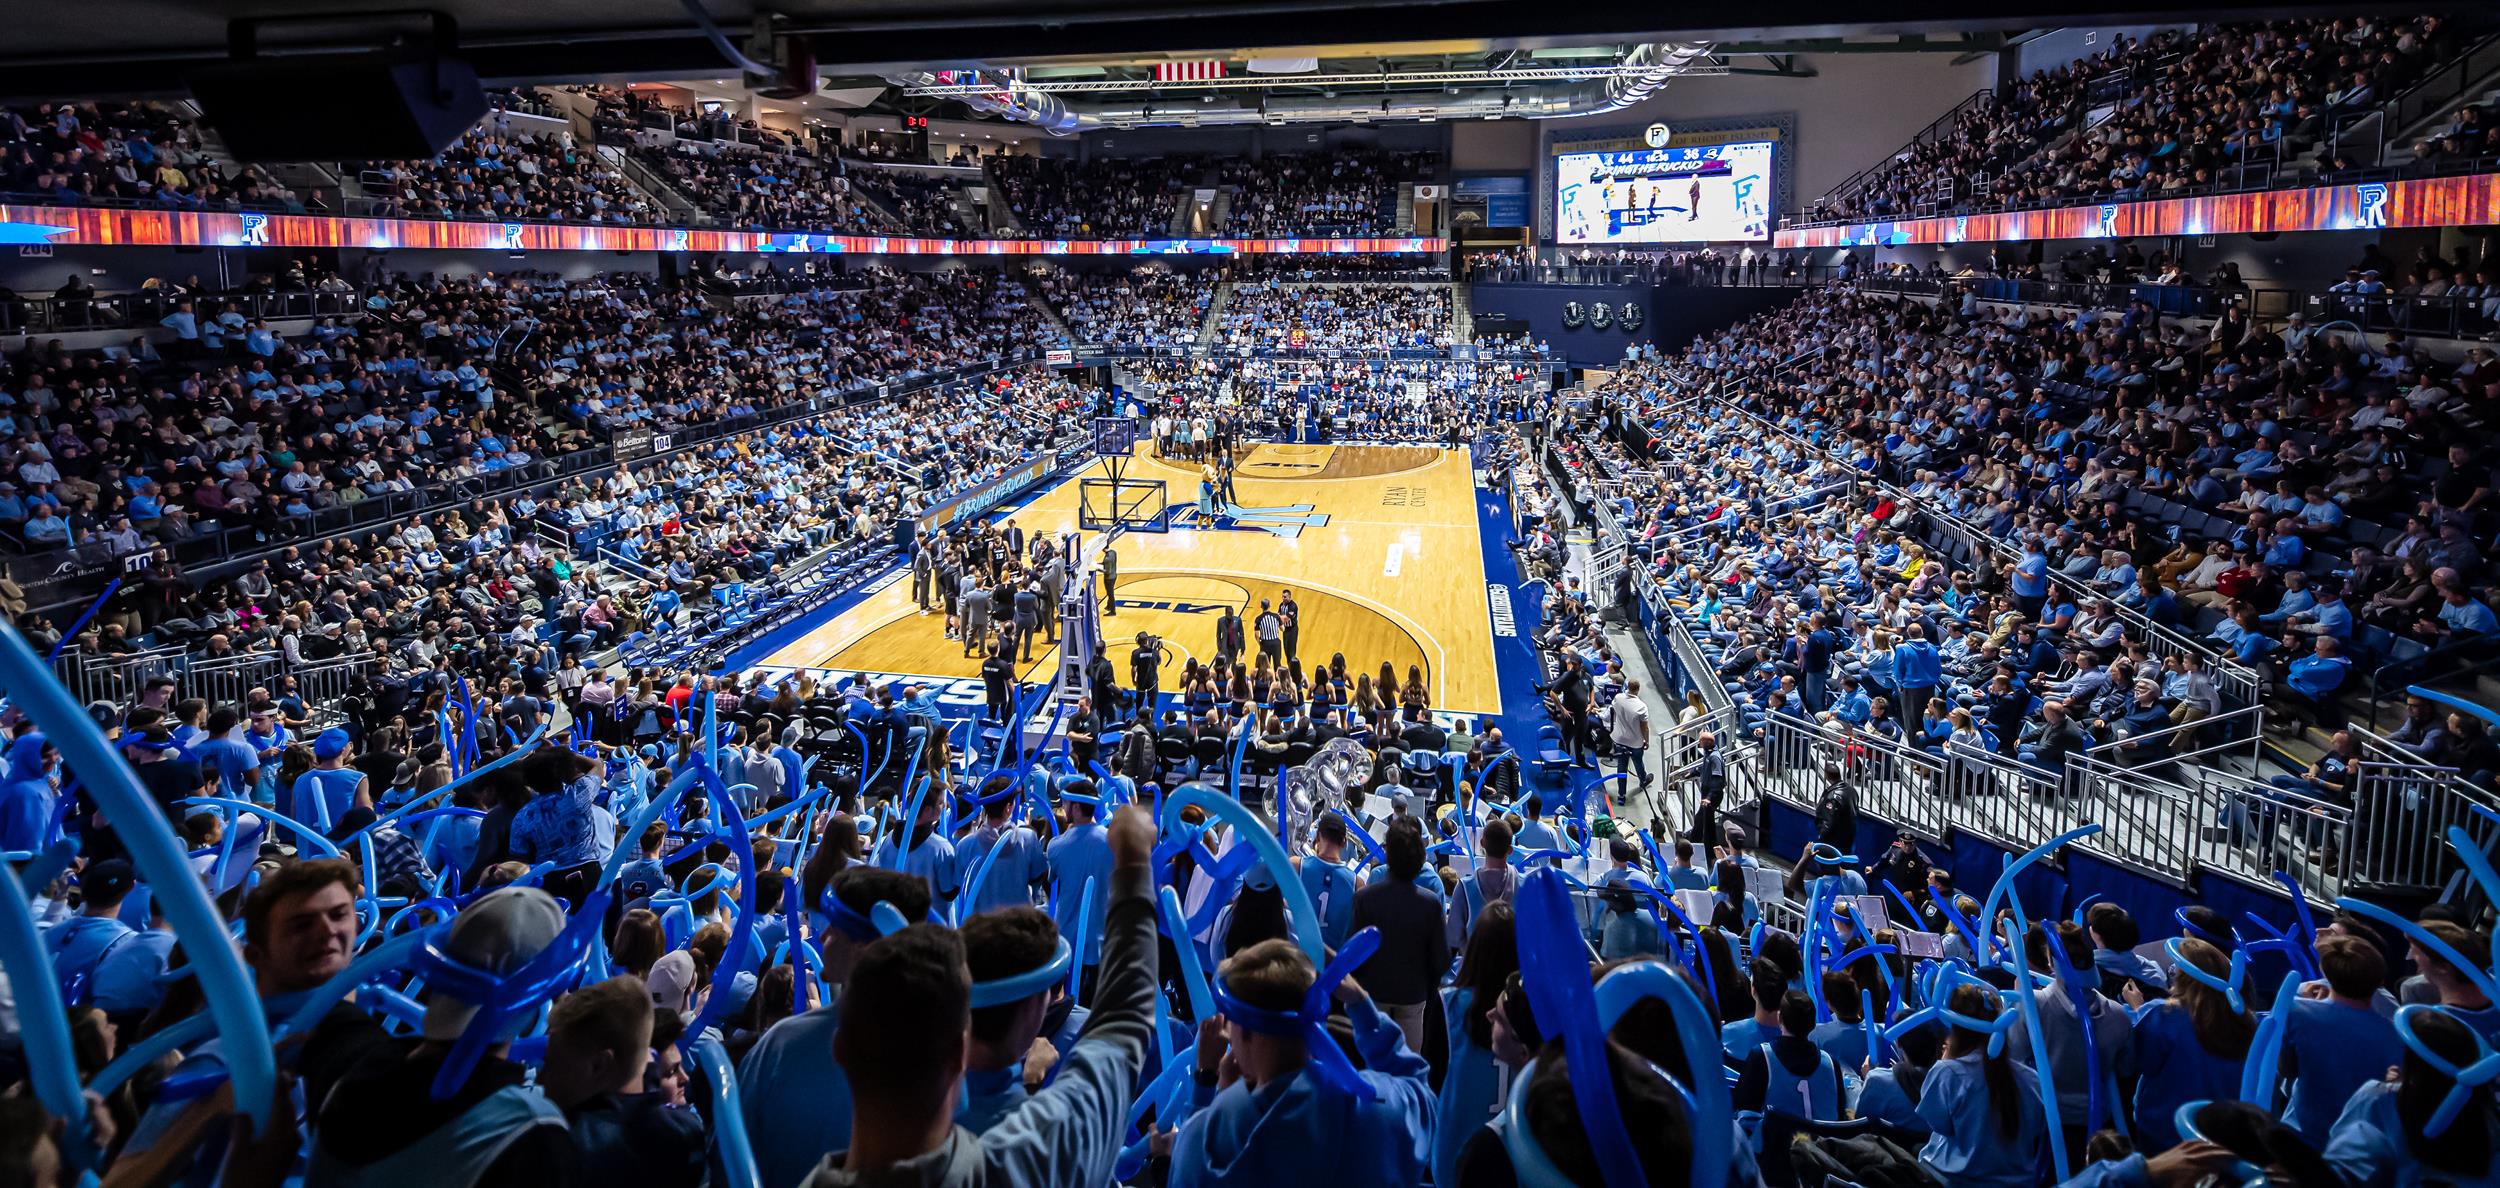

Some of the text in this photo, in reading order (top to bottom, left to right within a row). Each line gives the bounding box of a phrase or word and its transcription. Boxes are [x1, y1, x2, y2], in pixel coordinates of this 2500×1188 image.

[623, 437, 648, 447] Beltone
[656, 437, 669, 450] 104
[1382, 486, 1407, 506] RYAN
[45, 573, 75, 585] COUNTY
[77, 566, 105, 577] HEALTH
[1318, 891, 1330, 927] 1
[1797, 1079, 1812, 1120] 1
